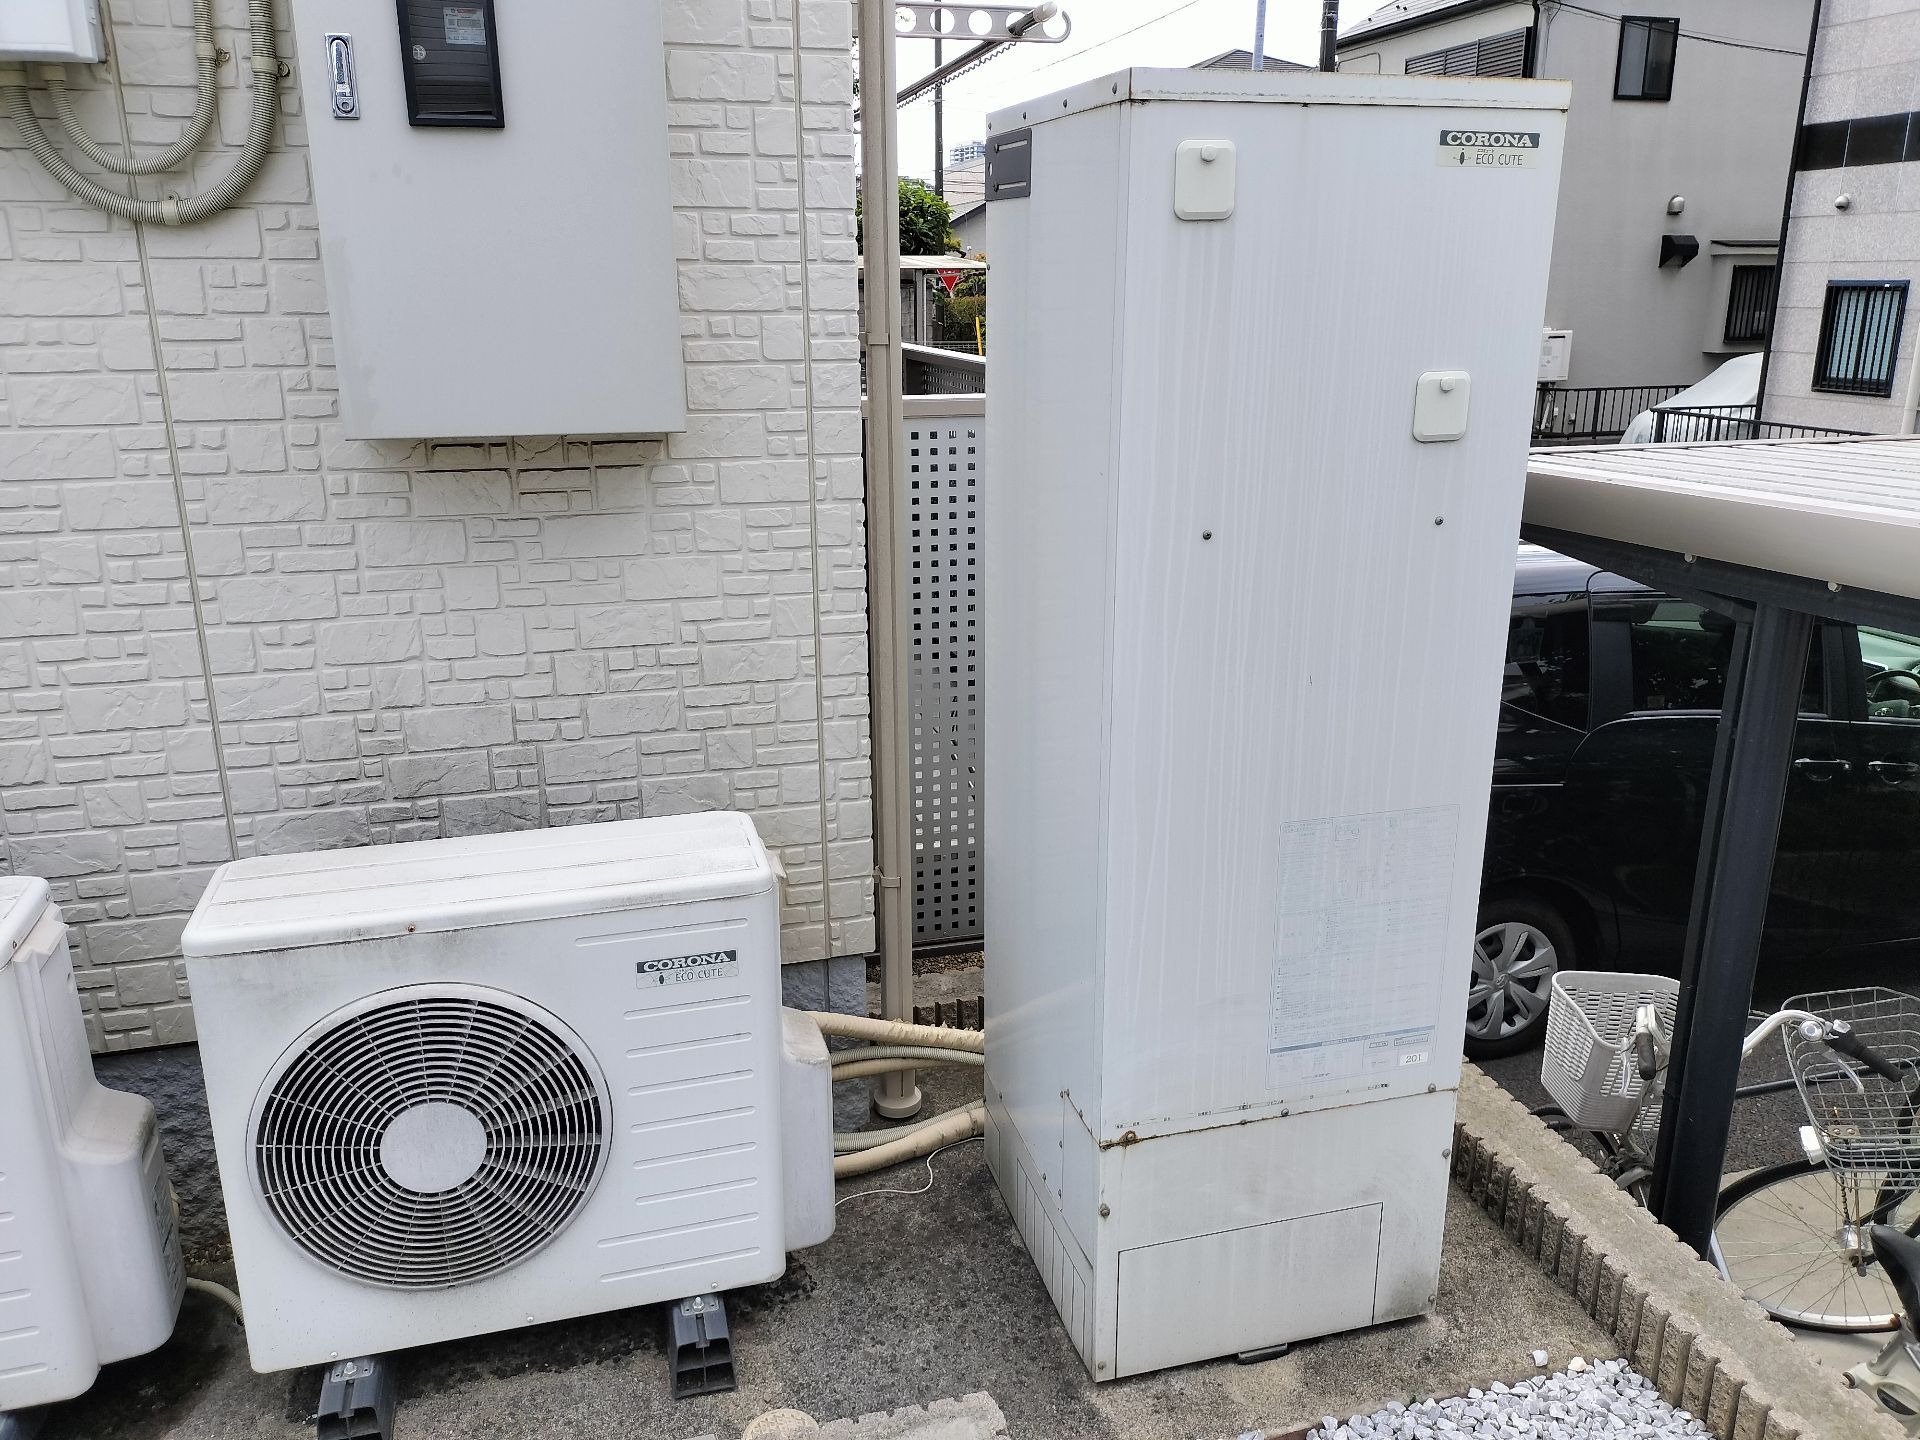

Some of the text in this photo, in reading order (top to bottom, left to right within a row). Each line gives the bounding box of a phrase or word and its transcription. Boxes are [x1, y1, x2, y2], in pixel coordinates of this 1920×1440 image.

[1446, 131, 1533, 147] CORONA
[1475, 153, 1524, 166] ECO CUTE
[643, 952, 731, 972] CORONA
[675, 967, 723, 982] ECO CUTE
[1405, 1053, 1421, 1064] 201
